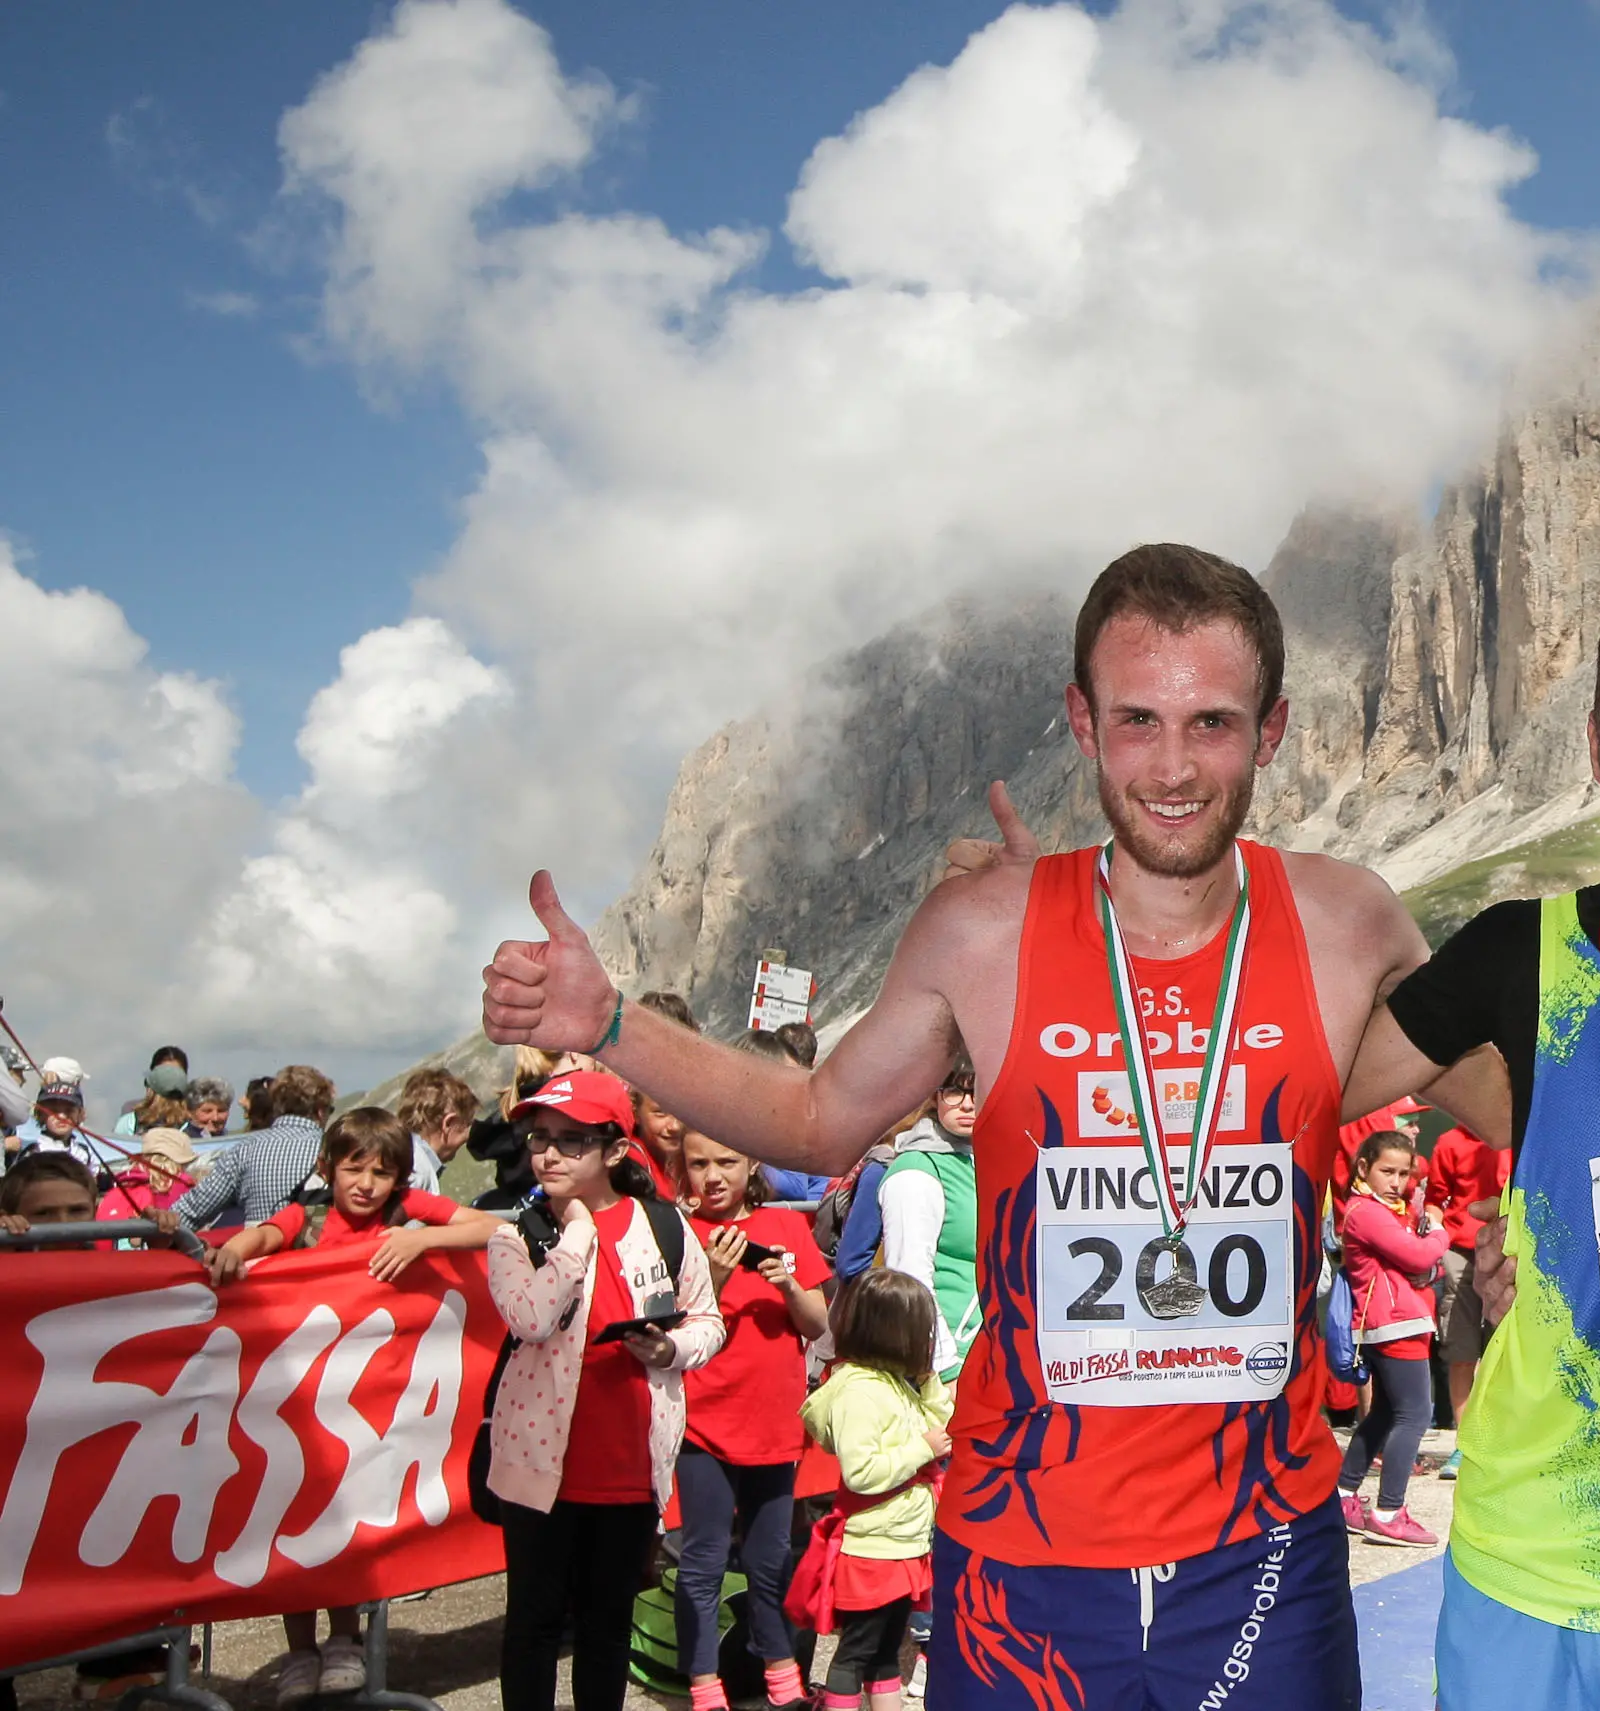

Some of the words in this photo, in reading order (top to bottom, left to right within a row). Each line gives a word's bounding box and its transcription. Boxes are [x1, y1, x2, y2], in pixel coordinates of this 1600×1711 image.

[1138, 986, 1190, 1017] G.S.
[1045, 1163, 1284, 1210] VINCENZO
[1066, 1233, 1268, 1321] 200
[1087, 1349, 1129, 1377] FASSA
[1136, 1345, 1244, 1369] RUNNING
[1248, 1358, 1286, 1370] VOLVO
[0, 1283, 467, 1595] FASSA
